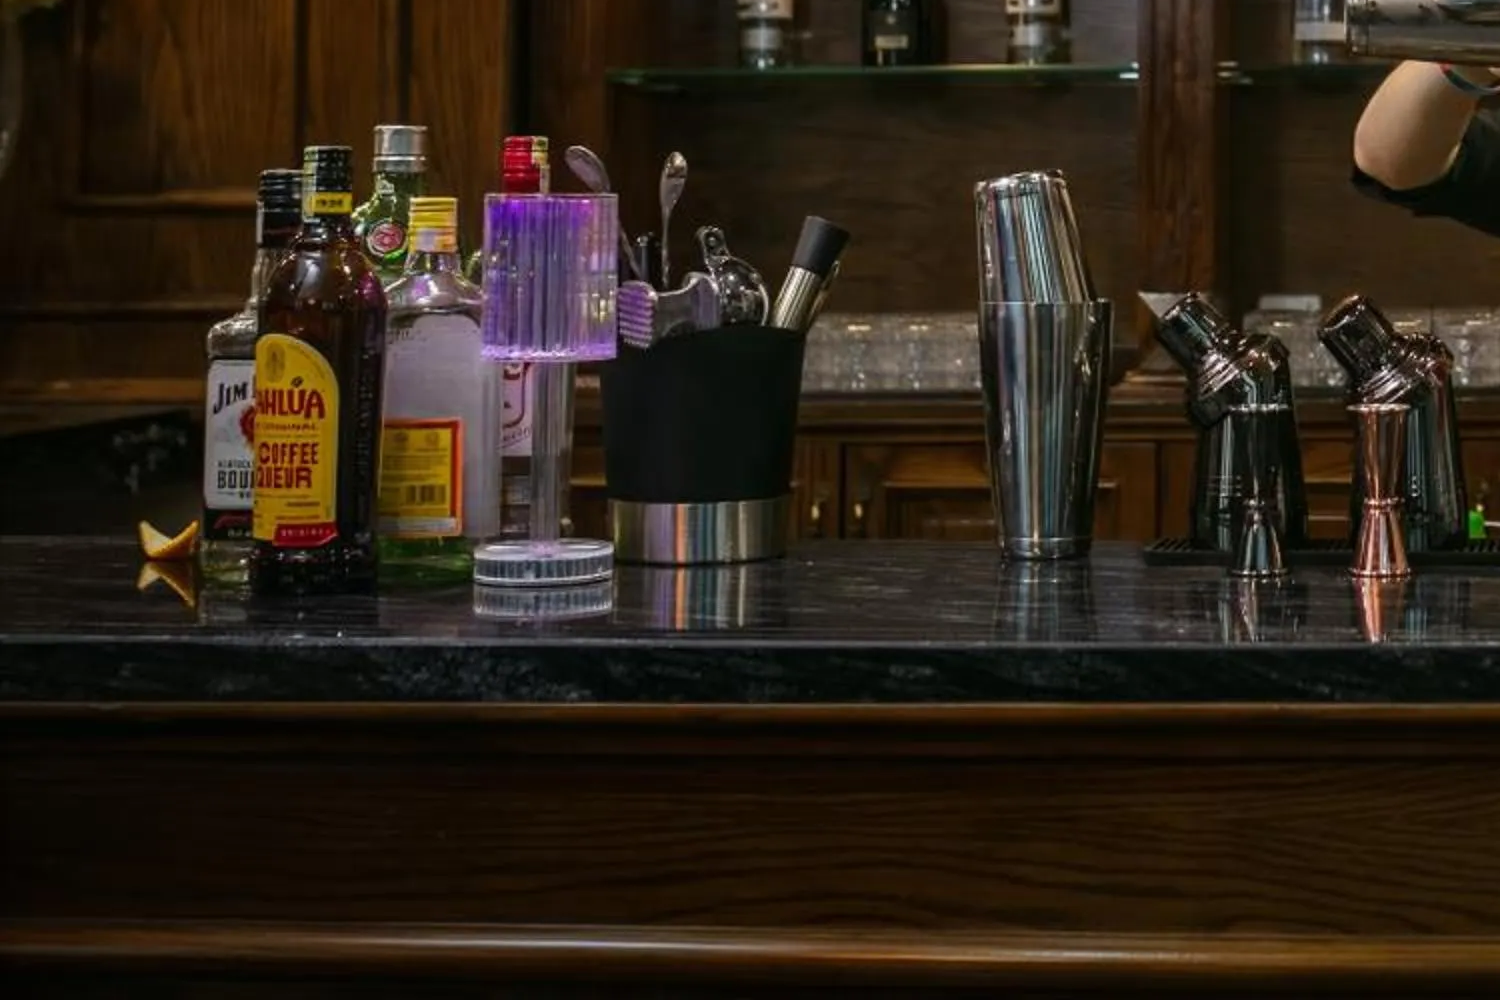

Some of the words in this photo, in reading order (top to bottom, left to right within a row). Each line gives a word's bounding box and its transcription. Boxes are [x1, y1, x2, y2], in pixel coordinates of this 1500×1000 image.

[213, 382, 248, 415] JIM
[255, 377, 325, 420] AHLÚA
[258, 441, 320, 465] COFFEE
[255, 466, 313, 489] QUEUR
